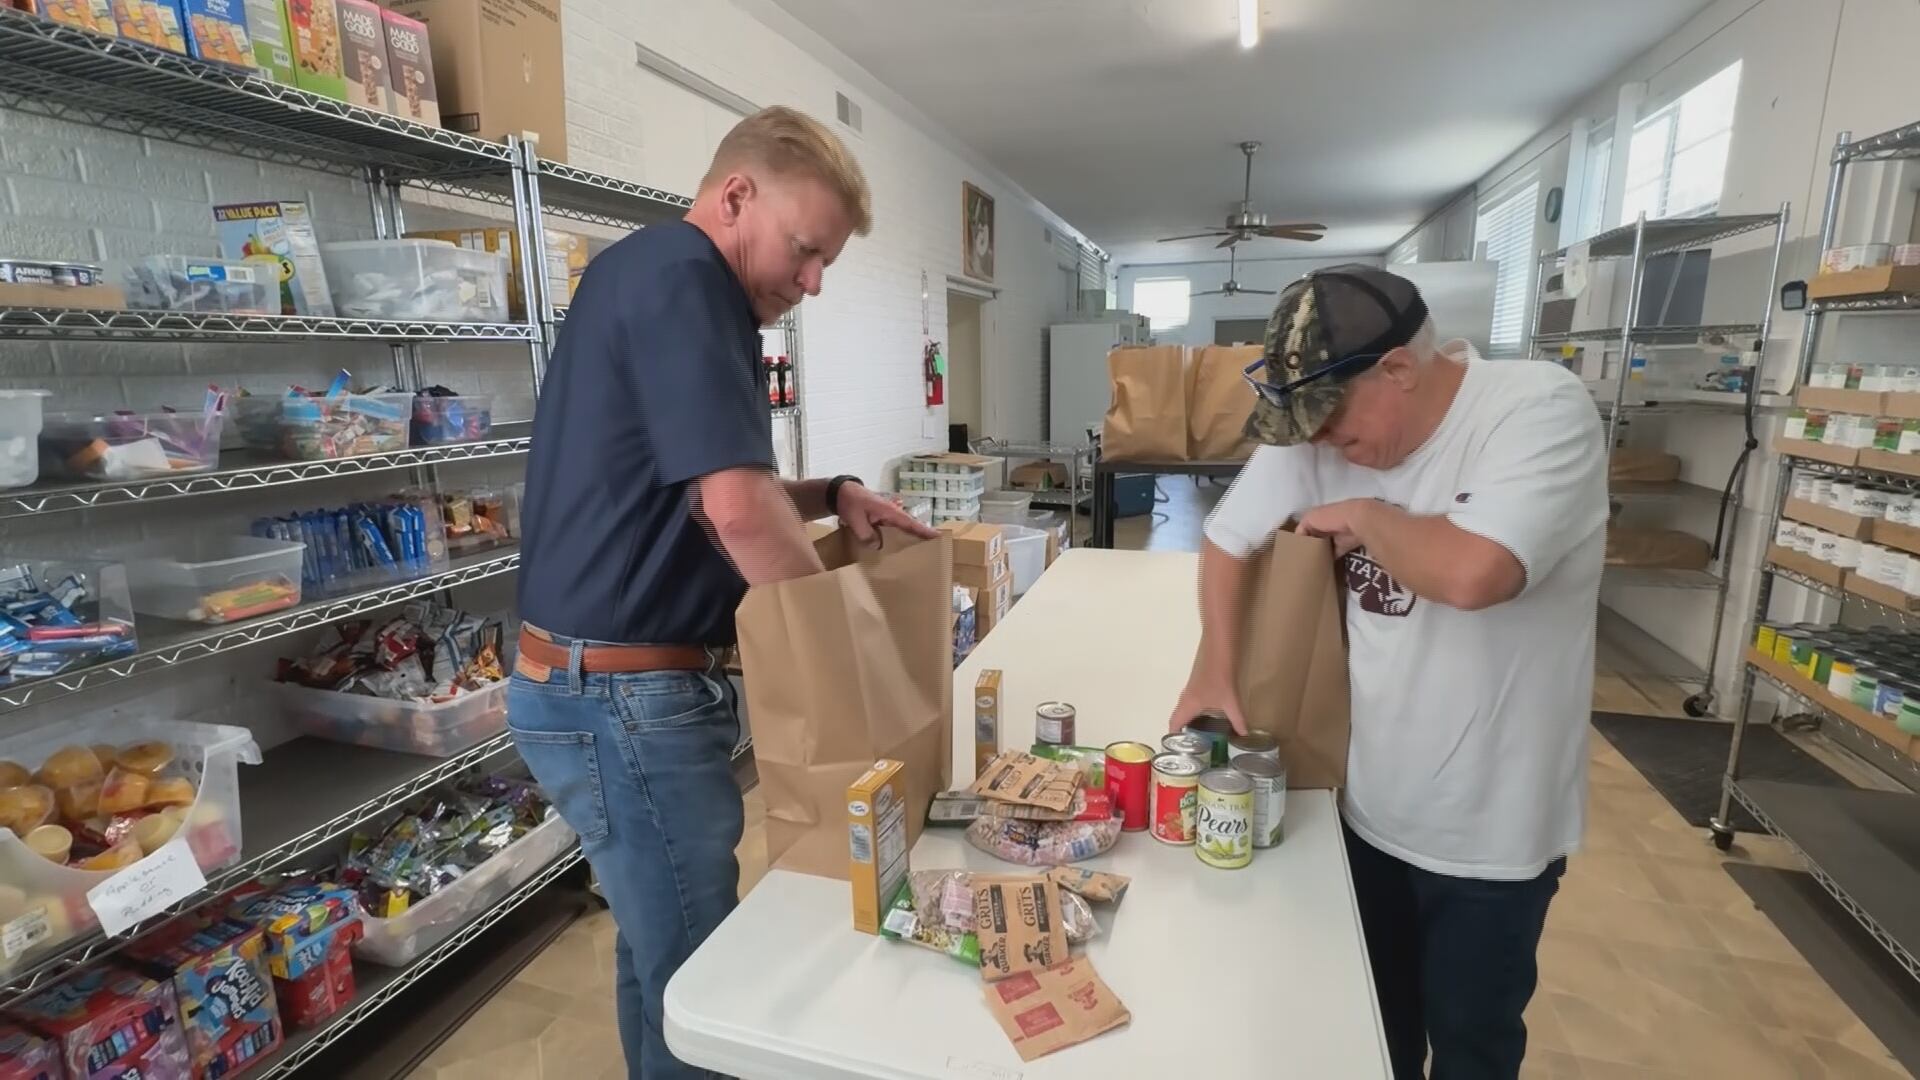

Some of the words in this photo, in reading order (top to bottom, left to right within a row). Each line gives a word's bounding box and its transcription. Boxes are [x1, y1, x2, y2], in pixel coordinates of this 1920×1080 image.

[343, 9, 374, 29] MADE
[344, 20, 376, 39] GOOD
[390, 27, 417, 42] MADE
[391, 36, 420, 54] GOOD
[225, 206, 254, 219] VALUE
[254, 205, 280, 217] PACK
[15, 267, 53, 277] ARMOU
[1198, 804, 1248, 834] Pears
[977, 888, 992, 930] GRITS
[1021, 886, 1036, 927] GRITS
[998, 936, 1010, 974] QUAKER
[210, 980, 247, 1019] Jammers
